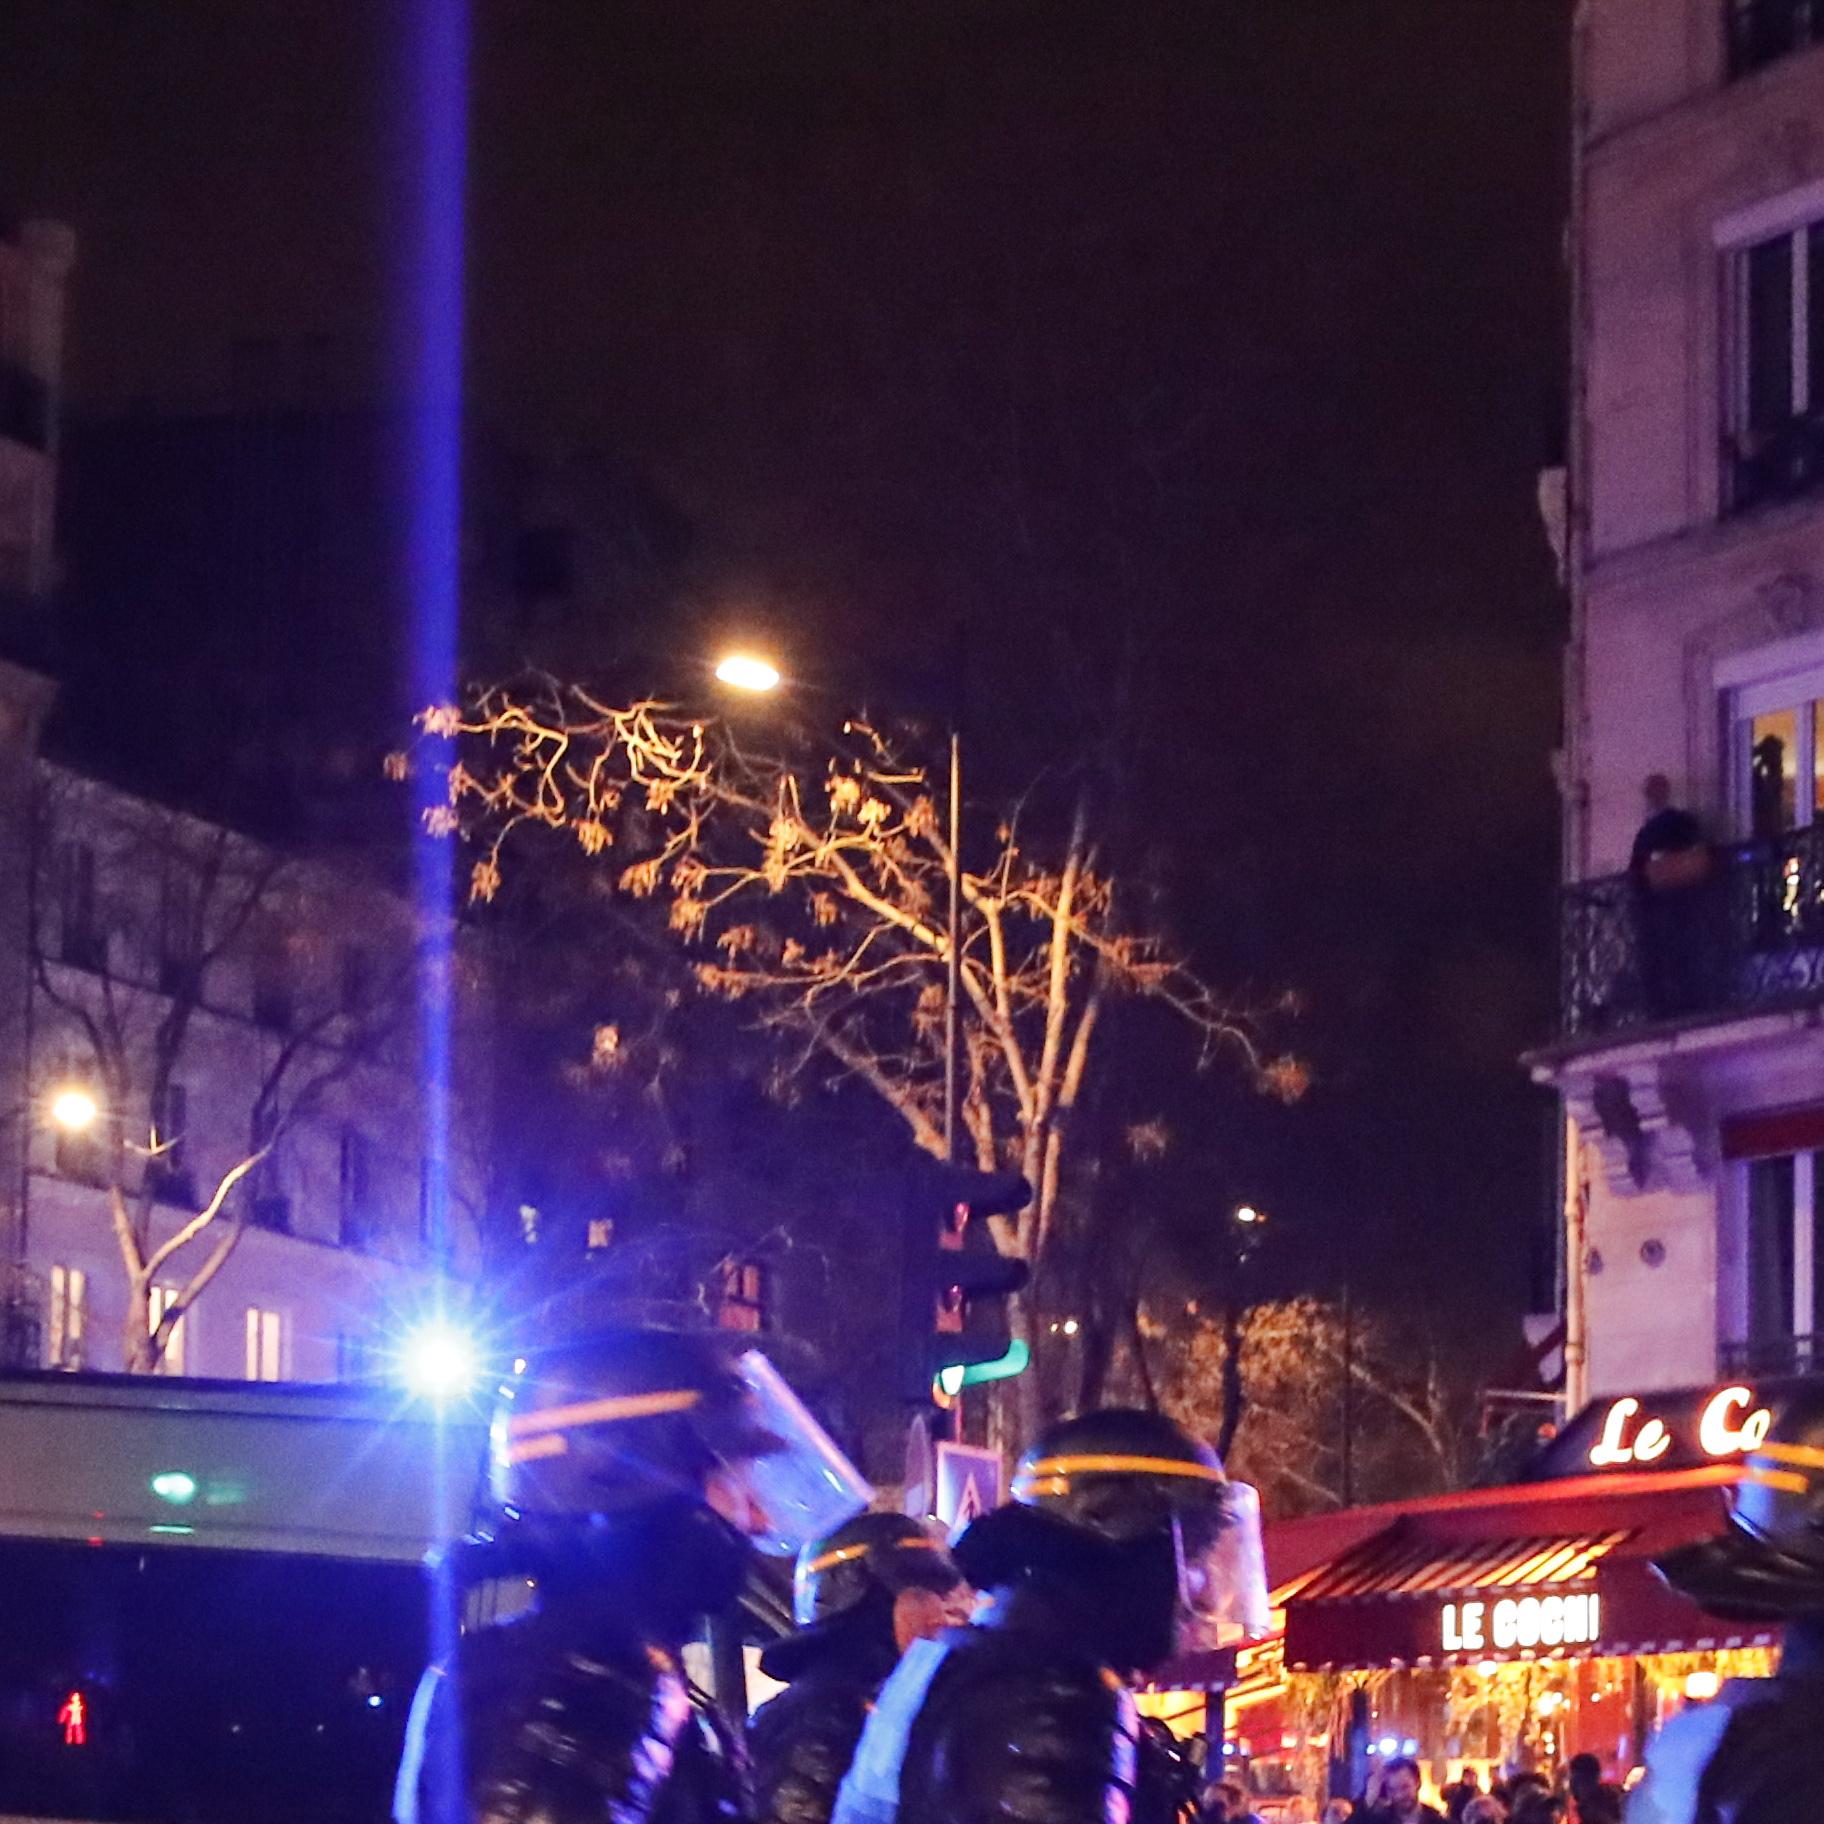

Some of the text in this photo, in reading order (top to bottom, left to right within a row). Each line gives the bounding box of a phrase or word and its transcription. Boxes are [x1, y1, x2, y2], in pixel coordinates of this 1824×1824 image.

[1590, 1387, 1771, 1465] Le Co
[1442, 1603, 1484, 1650] LE
